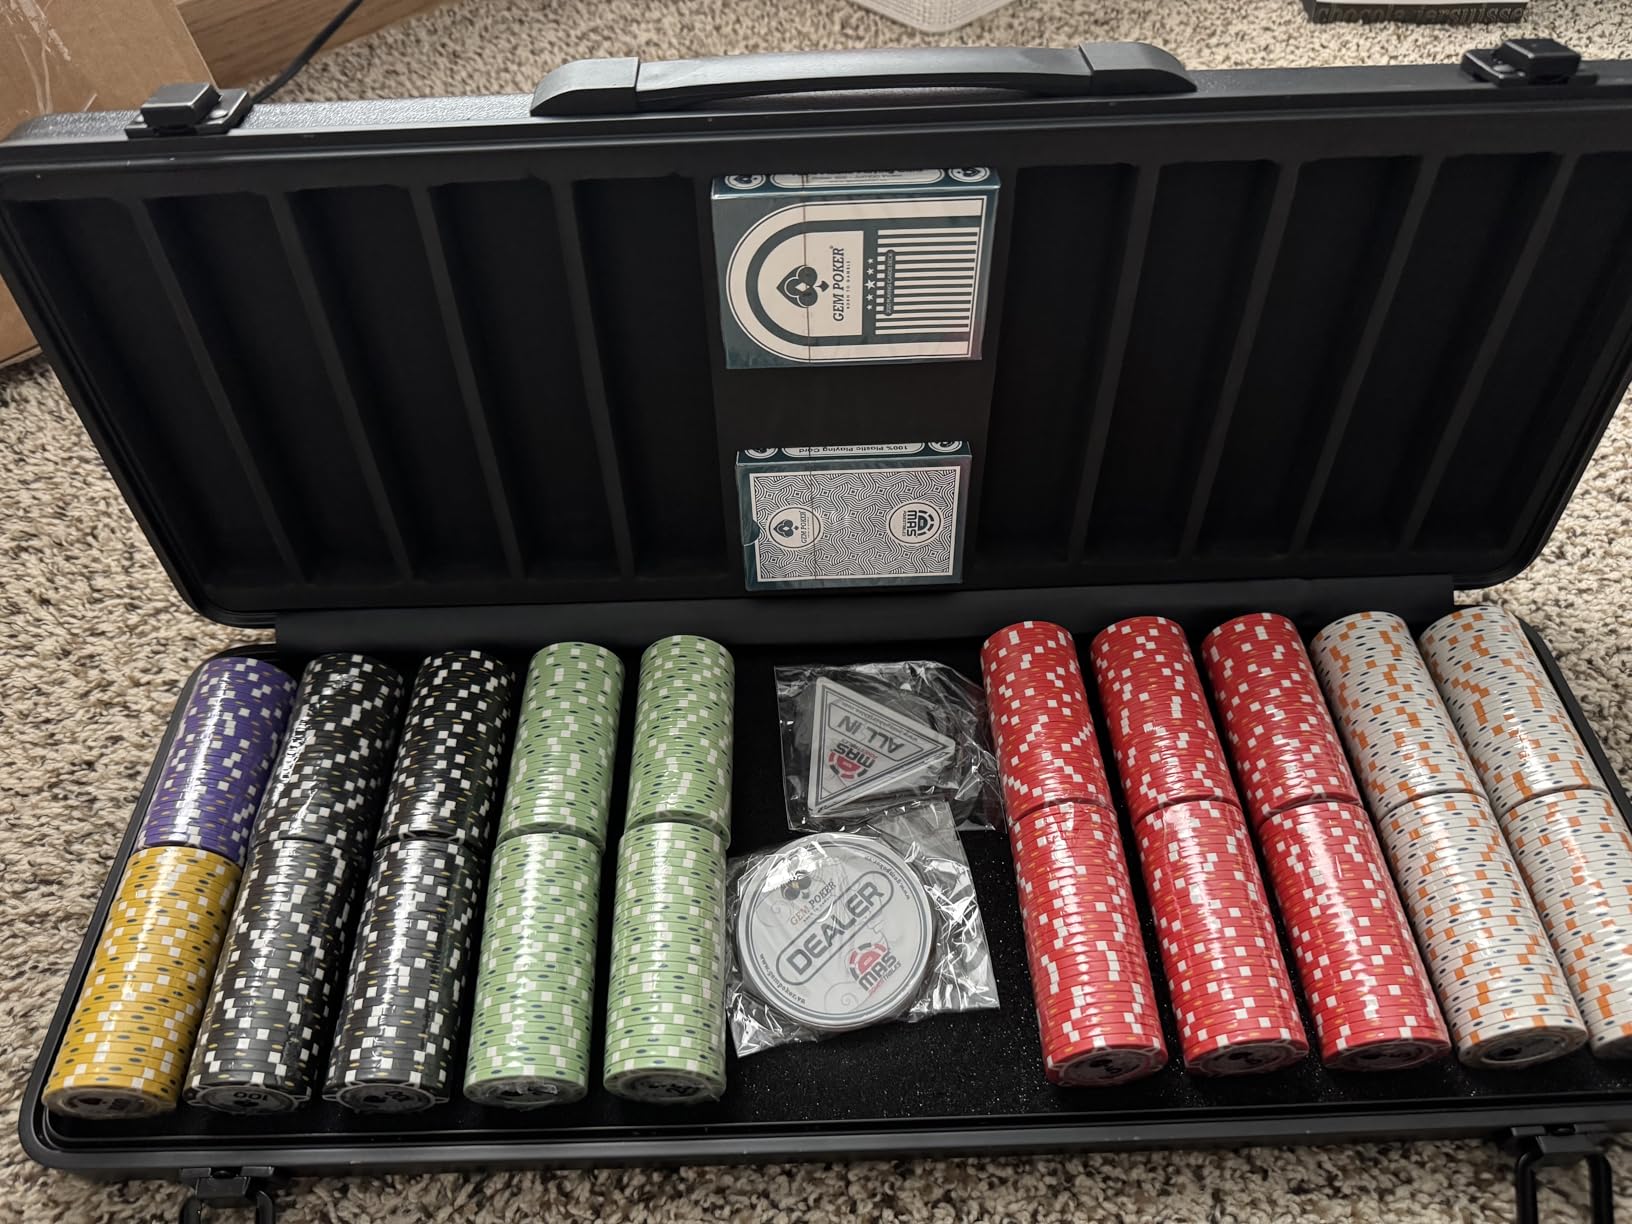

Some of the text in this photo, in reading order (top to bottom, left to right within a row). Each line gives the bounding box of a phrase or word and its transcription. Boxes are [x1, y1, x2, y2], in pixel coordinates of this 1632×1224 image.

[832, 247, 845, 322] GEM POKER
[822, 446, 854, 454] Playing
[906, 510, 917, 537] MAS
[836, 715, 904, 754] ALL IN
[833, 743, 876, 769] MAS
[790, 881, 837, 926] GEM POKER
[786, 881, 885, 976] DEALER
[858, 948, 898, 992] MAS
[233, 1091, 268, 1101] 100
